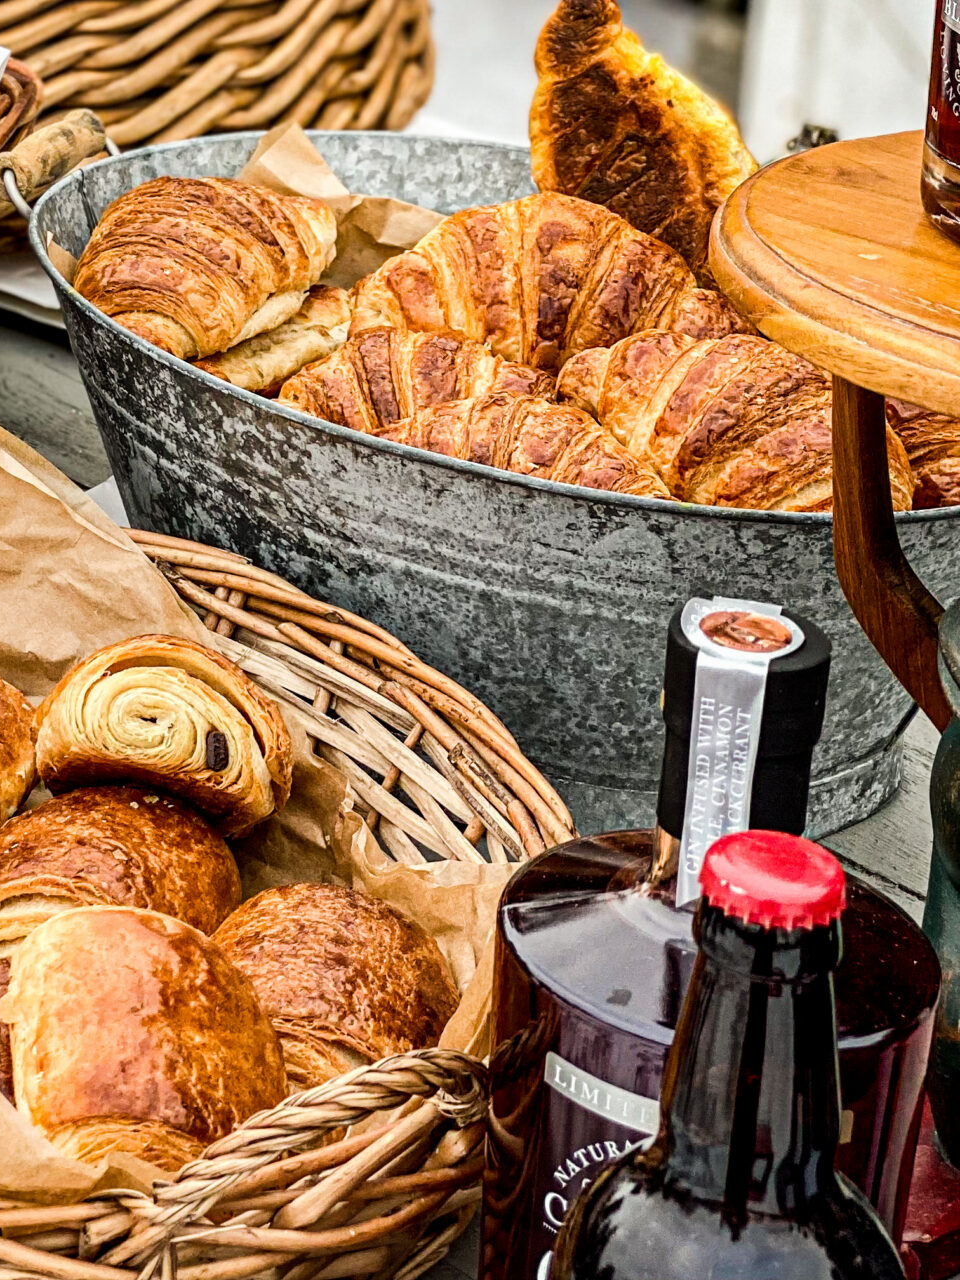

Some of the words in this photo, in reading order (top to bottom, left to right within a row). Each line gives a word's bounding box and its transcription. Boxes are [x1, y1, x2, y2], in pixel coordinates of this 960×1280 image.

[940, 31, 960, 117] LOVING
[697, 696, 716, 748] WITH
[711, 704, 733, 807] CINNAMON
[691, 754, 710, 835] INFUSED
[727, 707, 752, 833] ACKCURRANT
[685, 839, 702, 875] GIN
[553, 1064, 654, 1124] LIMITE
[553, 1139, 633, 1188] NATURA
